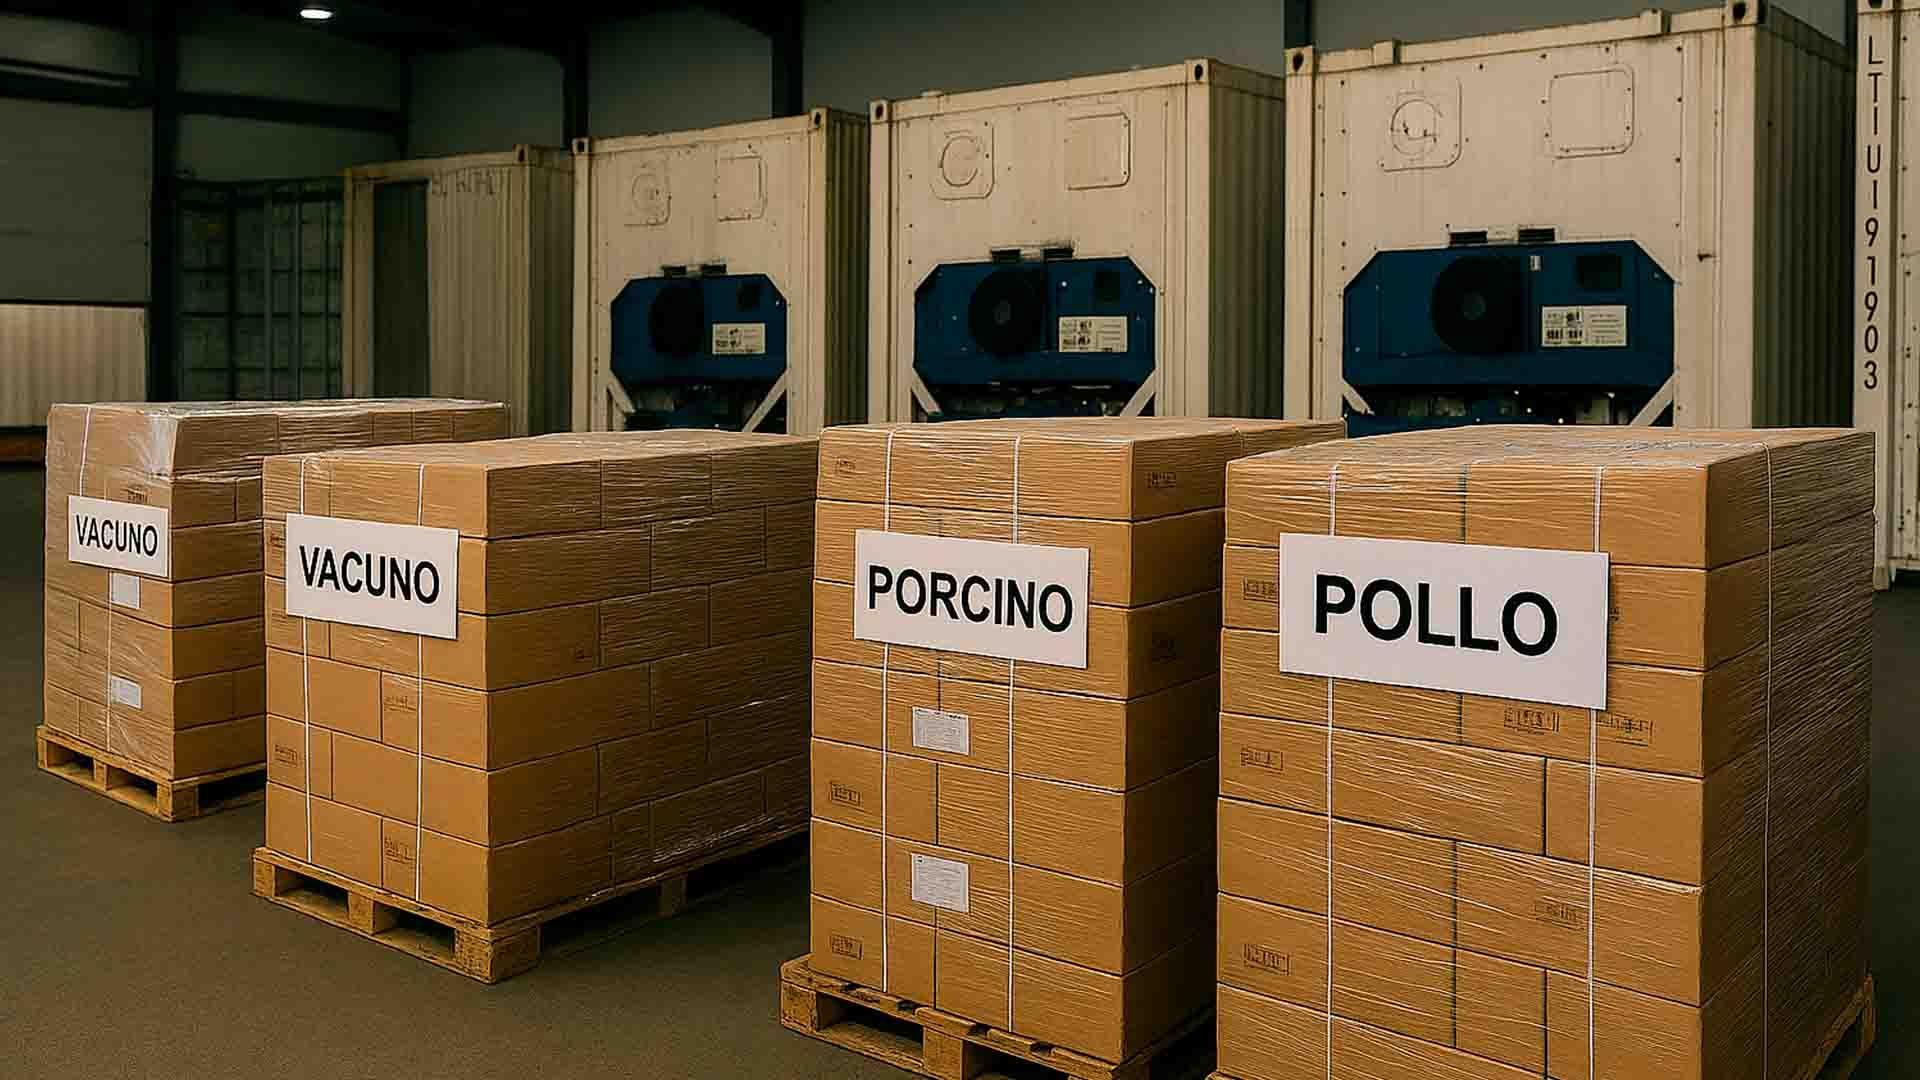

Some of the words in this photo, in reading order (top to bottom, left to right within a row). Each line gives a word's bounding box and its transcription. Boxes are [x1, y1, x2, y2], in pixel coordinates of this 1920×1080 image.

[75, 514, 158, 557] VACUNO
[299, 545, 440, 605] VACUNO
[869, 564, 1073, 633] PORCINO
[1315, 573, 1558, 657] POLLO
